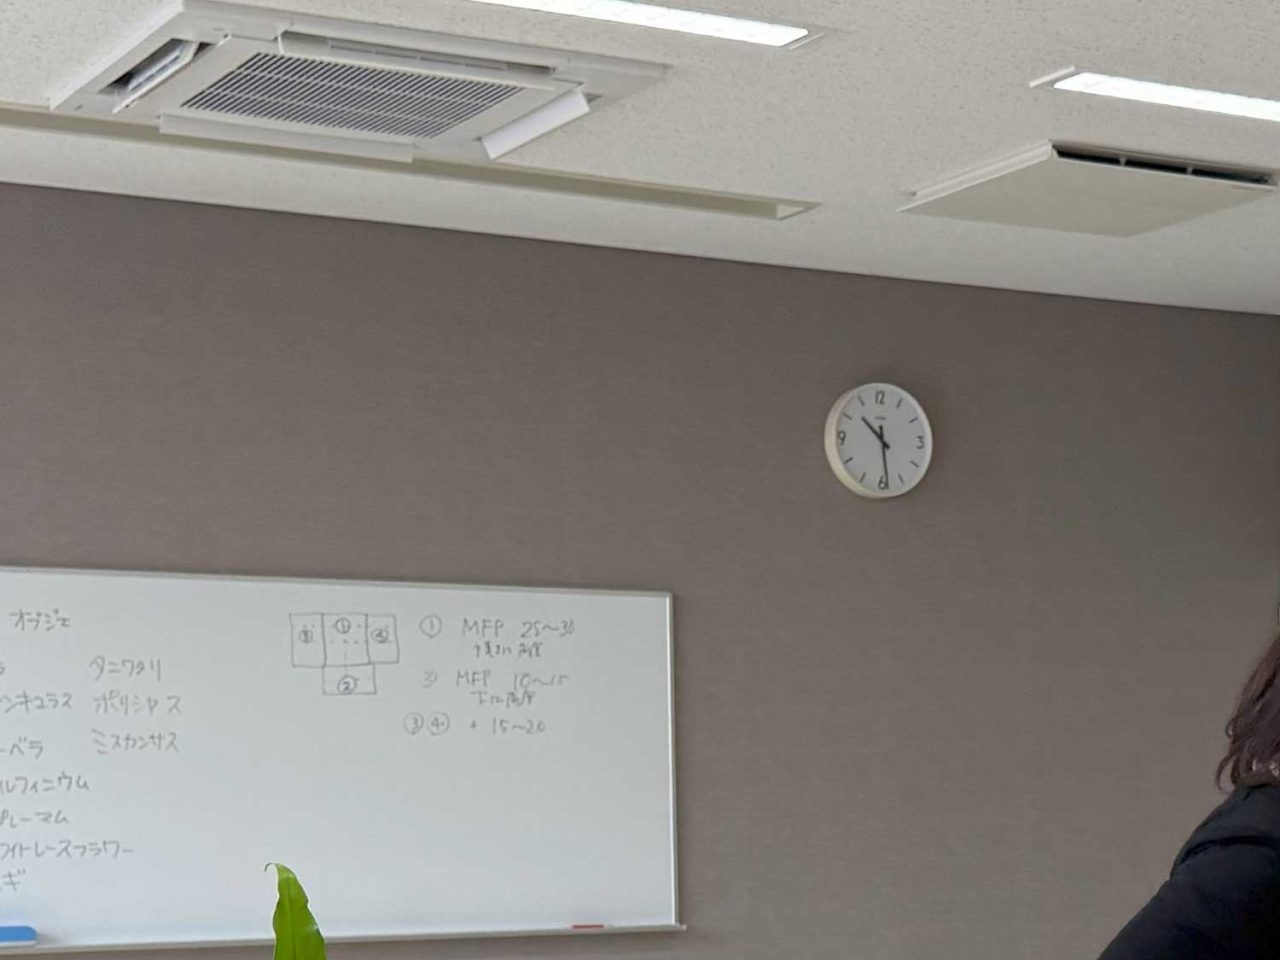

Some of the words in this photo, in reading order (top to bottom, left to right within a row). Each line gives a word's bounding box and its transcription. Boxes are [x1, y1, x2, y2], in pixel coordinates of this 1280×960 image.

[875, 390, 886, 404] 12
[837, 431, 846, 446] 9
[916, 435, 925, 449] 3
[877, 475, 888, 490] 6
[0, 690, 73, 714] ンキュラス
